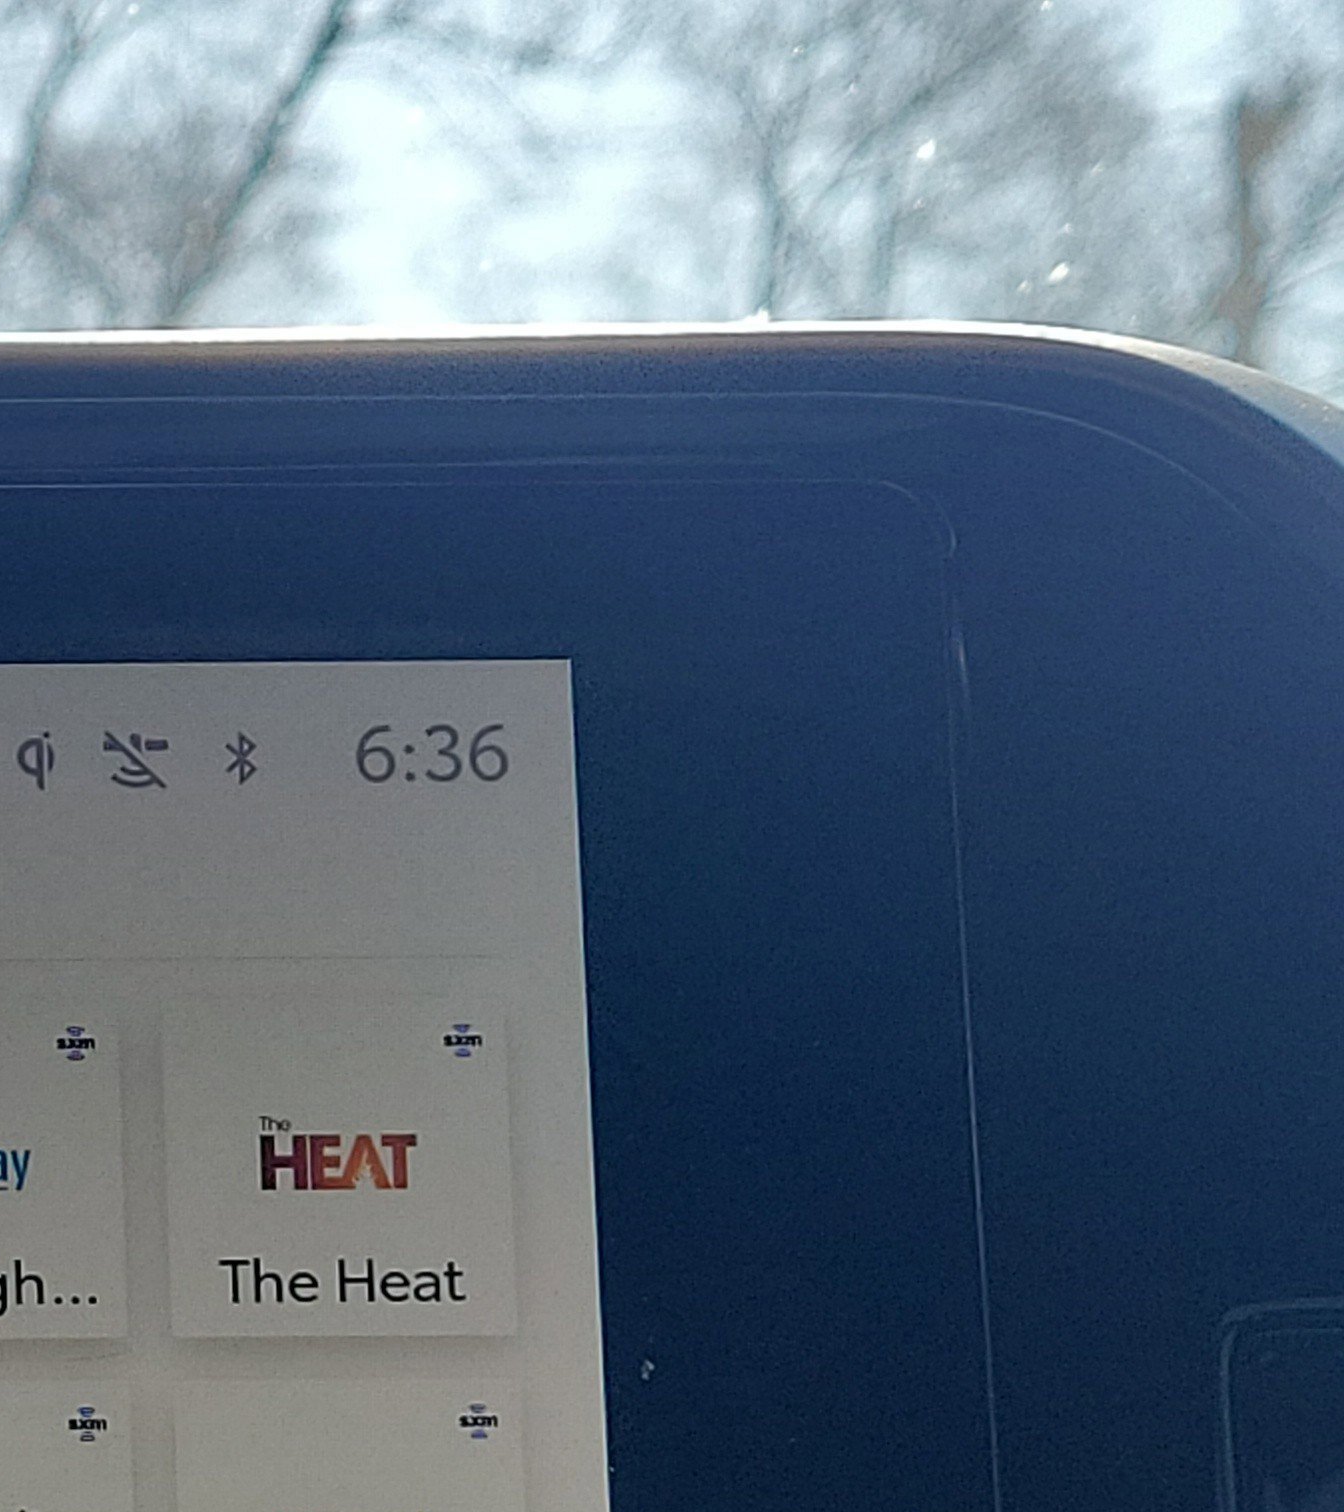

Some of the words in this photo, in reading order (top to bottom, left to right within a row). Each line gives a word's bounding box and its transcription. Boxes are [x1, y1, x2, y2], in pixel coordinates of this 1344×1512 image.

[355, 724, 509, 784] 6:36
[258, 1115, 292, 1132] The
[259, 1133, 417, 1190] HEAT
[218, 1257, 319, 1304] The
[338, 1258, 467, 1303] Heat
